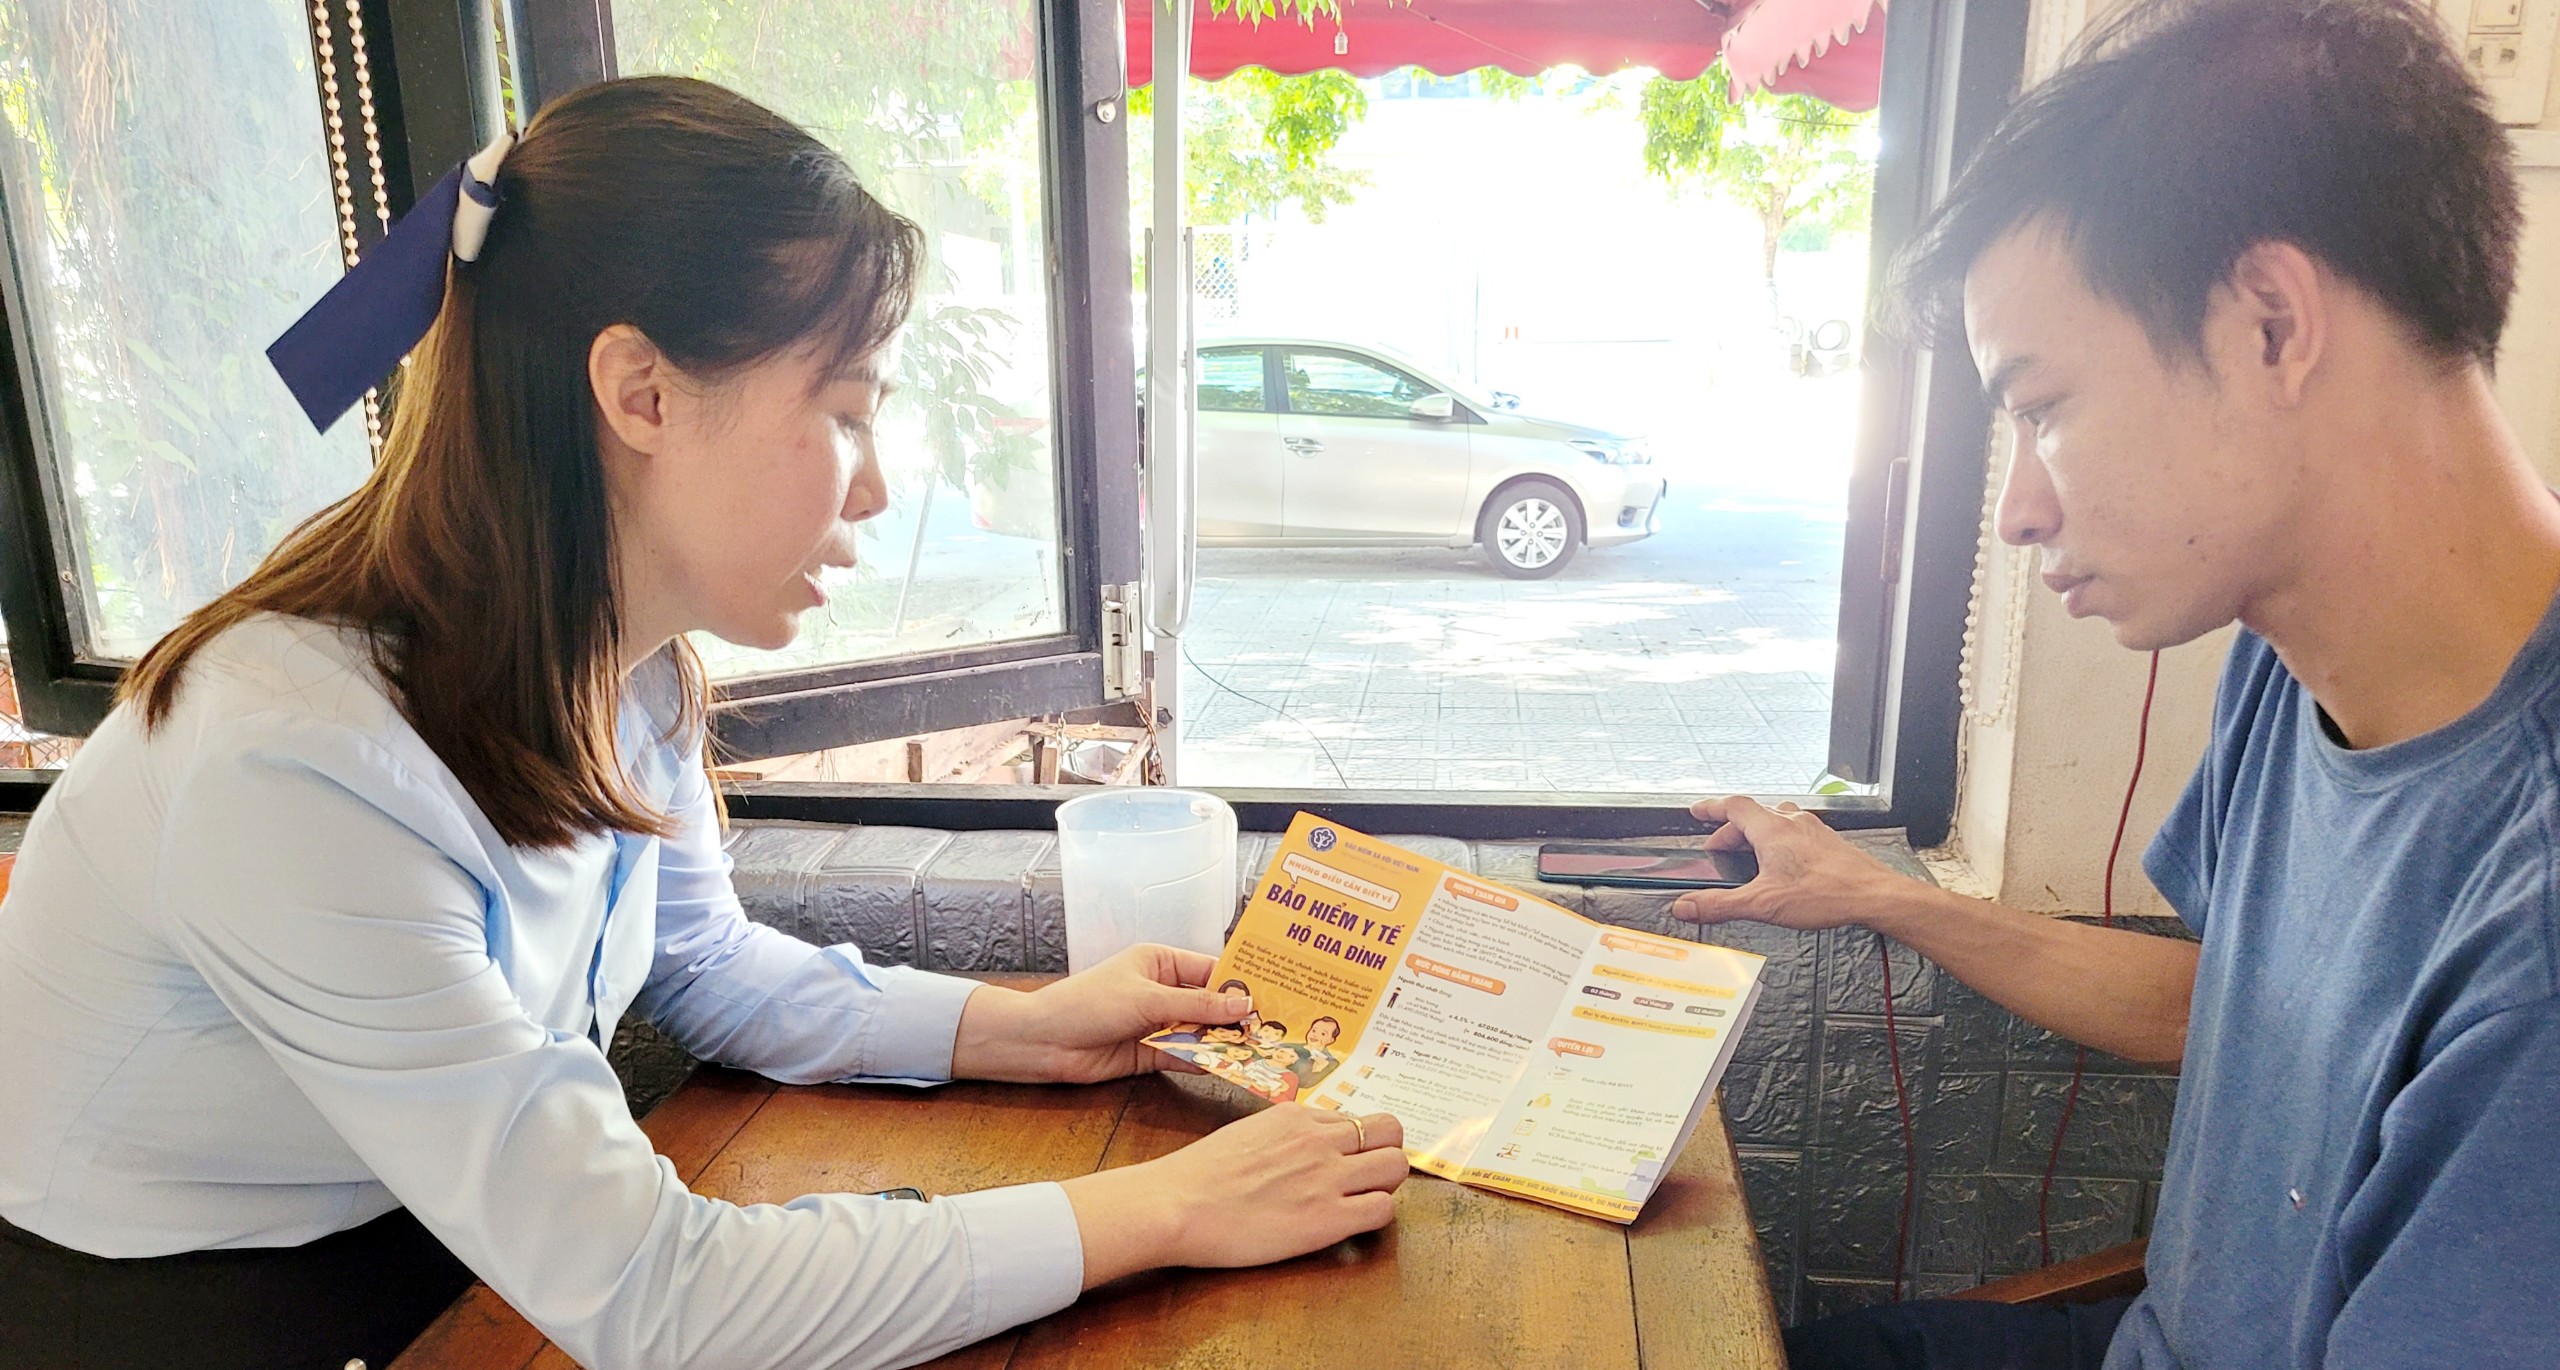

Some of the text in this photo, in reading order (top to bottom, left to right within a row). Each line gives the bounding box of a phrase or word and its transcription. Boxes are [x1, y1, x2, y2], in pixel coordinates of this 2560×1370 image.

[1321, 871, 1343, 885] ĐIỀU
[1343, 878, 1361, 893] CẦN
[1362, 886, 1381, 899] BIẾT
[1382, 894, 1394, 904] VỀ
[1266, 883, 1406, 946] BẢO HIỂM Y TẾ
[1286, 922, 1388, 971] HỘ GIA ĐÌNH
[1597, 989, 1617, 998] tháng
[1389, 1049, 1407, 1060] 70%
